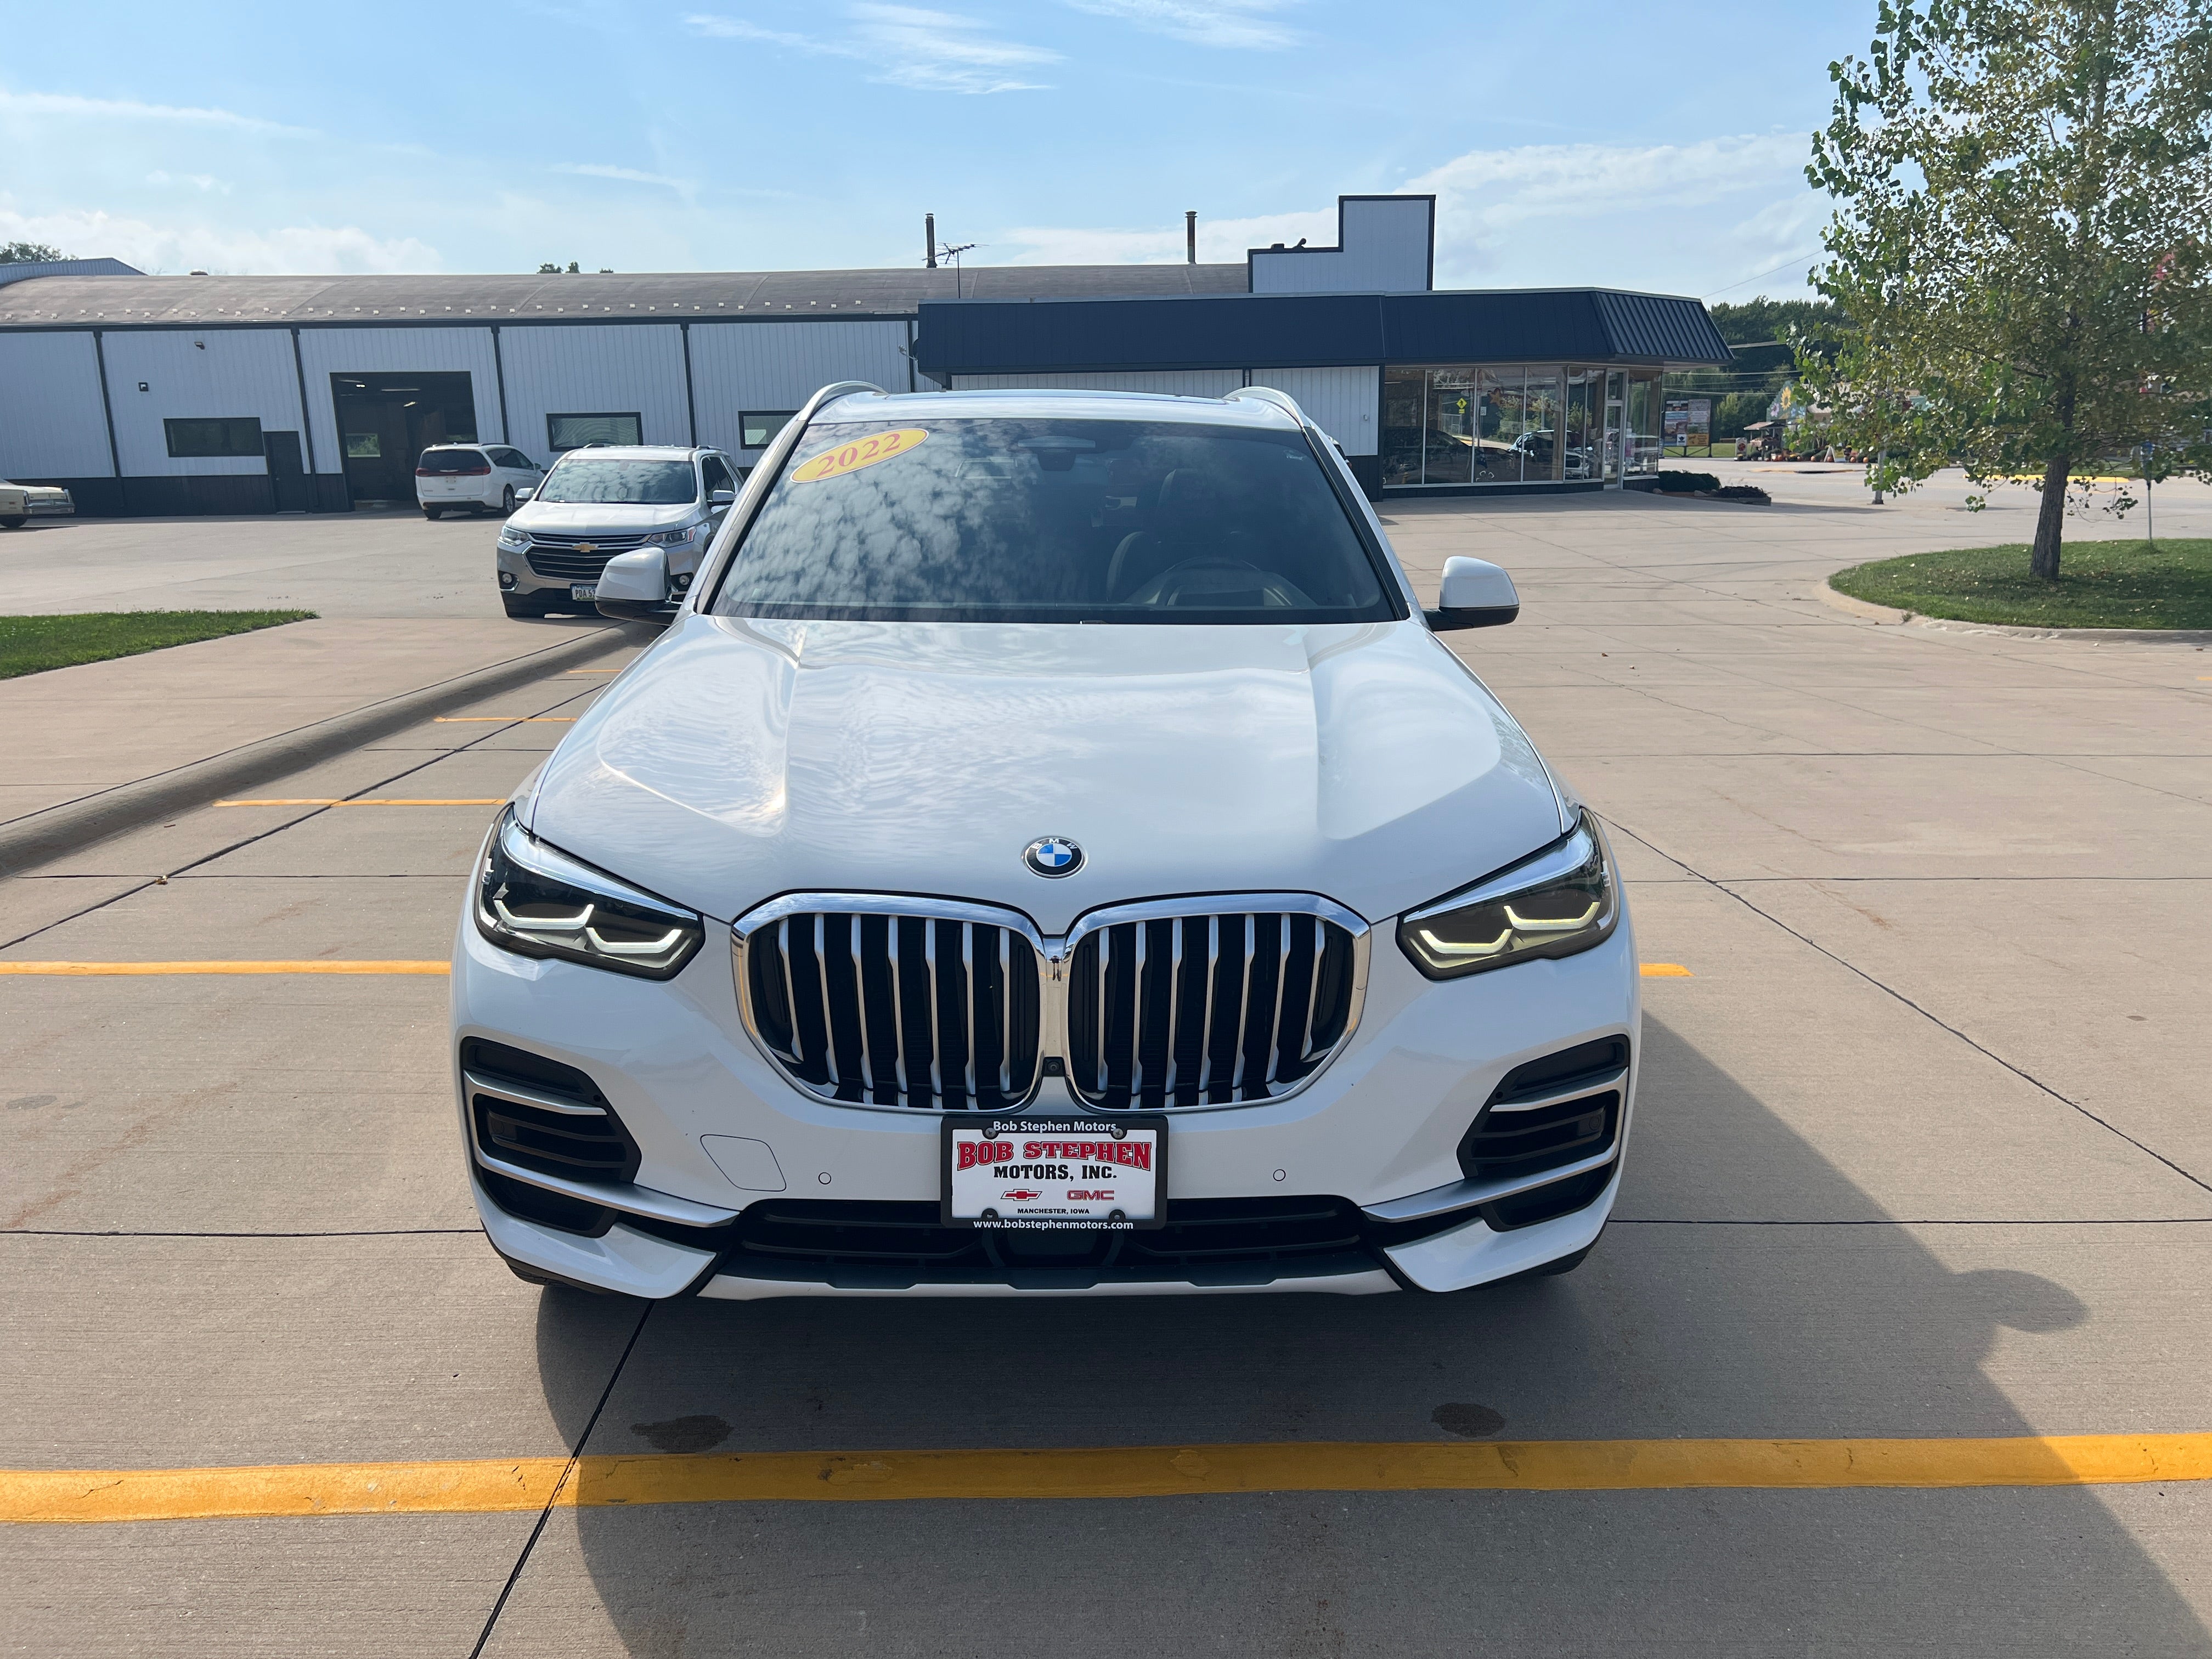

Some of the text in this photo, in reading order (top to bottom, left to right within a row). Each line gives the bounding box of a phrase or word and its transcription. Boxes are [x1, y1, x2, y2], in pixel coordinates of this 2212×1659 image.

[816, 433, 900, 477] 2022
[575, 589, 587, 597] PDA
[1031, 838, 1077, 850] BMW
[993, 1121, 1116, 1134] Bob Stephen Motors
[957, 1141, 1152, 1171] BOB STEPHEN
[994, 1165, 1117, 1181] MOTORS, INC.
[1066, 1189, 1115, 1201] GMC
[973, 1219, 1134, 1231] www.bobstephenmotors.com
